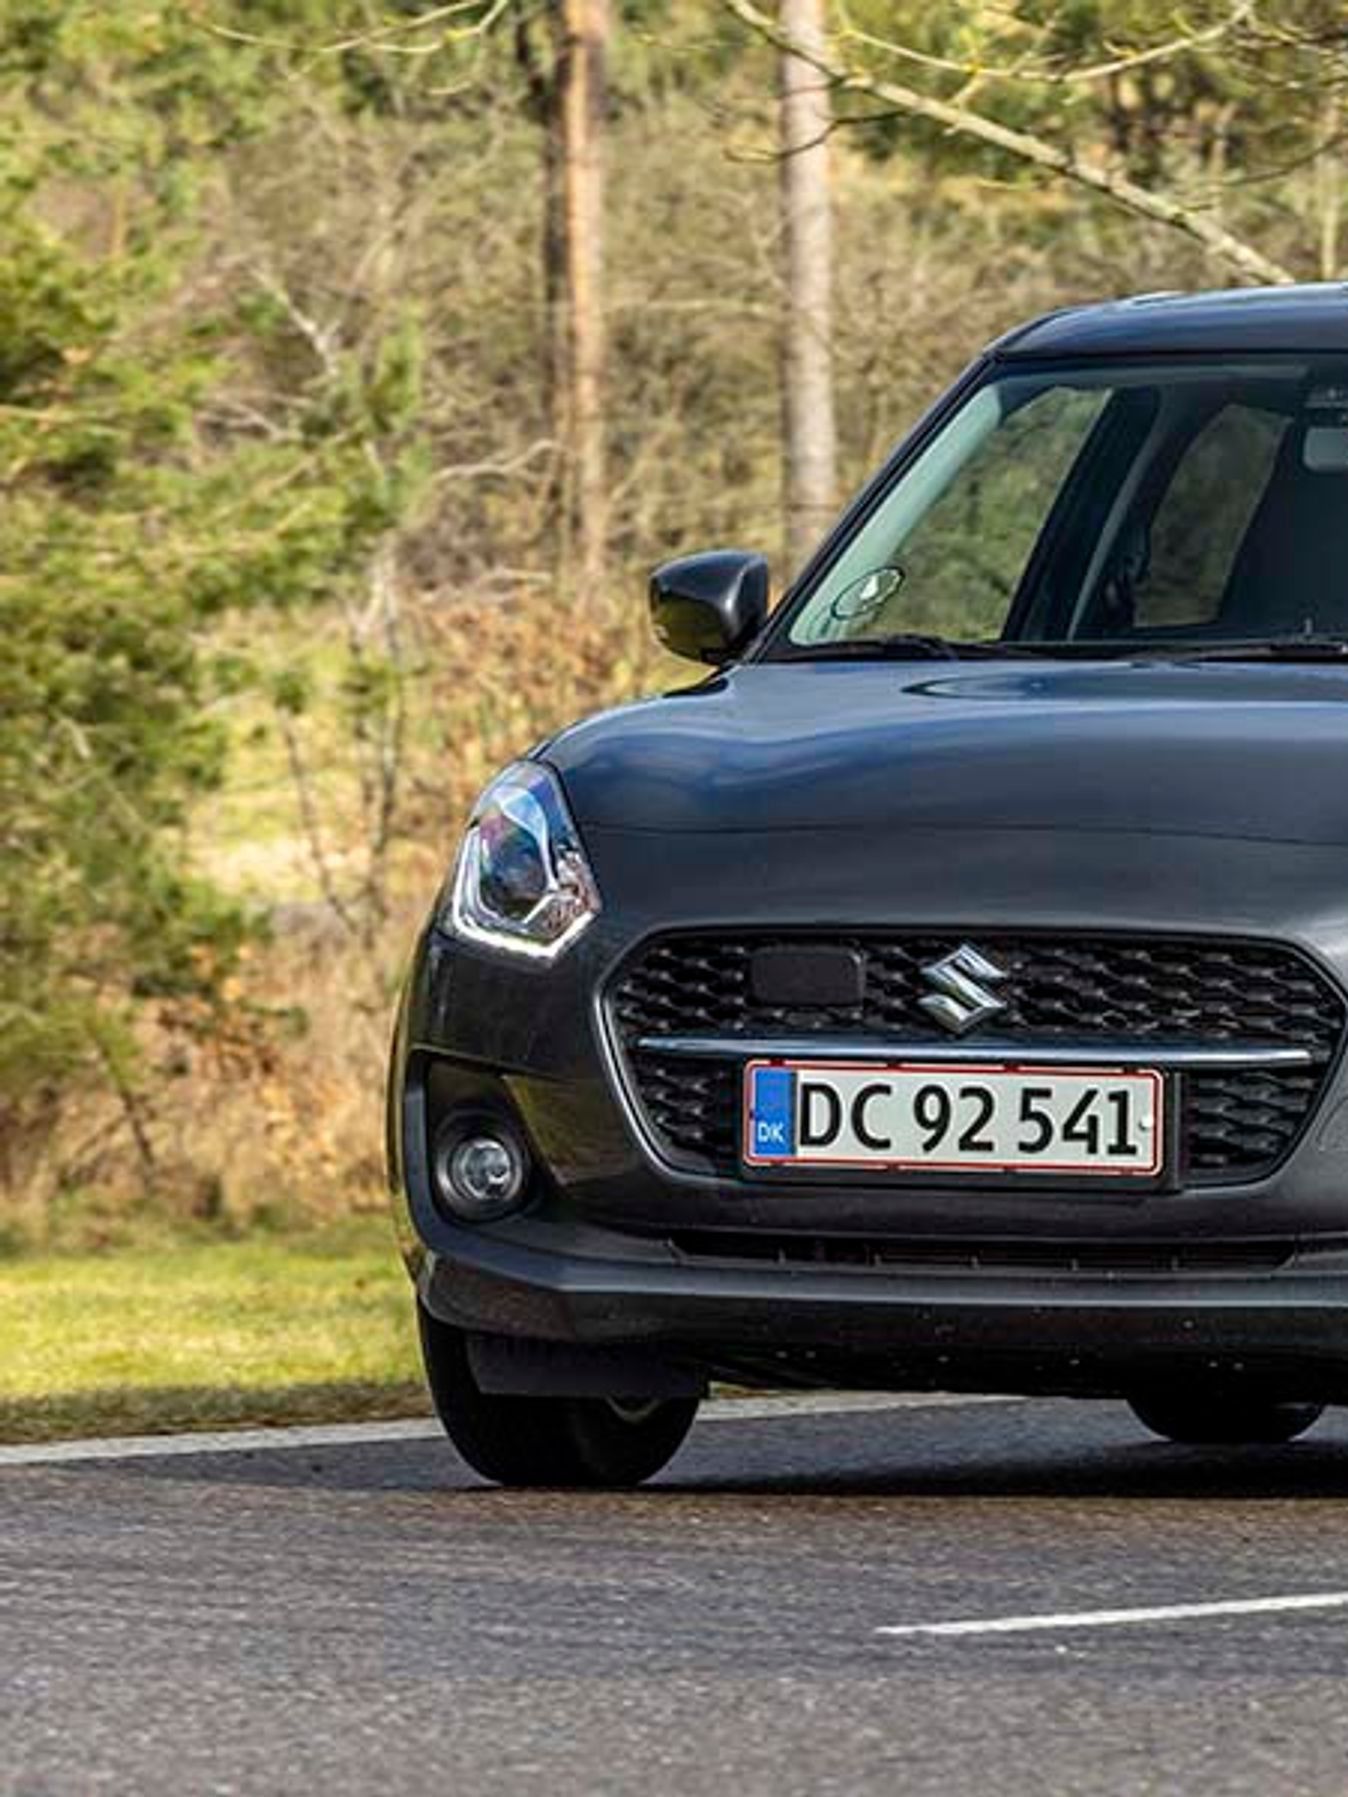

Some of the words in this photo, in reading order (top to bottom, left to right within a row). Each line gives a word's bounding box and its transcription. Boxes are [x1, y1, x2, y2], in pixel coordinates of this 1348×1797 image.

[758, 1122, 786, 1143] DK
[800, 1083, 893, 1150] DC
[913, 1084, 995, 1153] 92
[1018, 1087, 1138, 1155] 541
